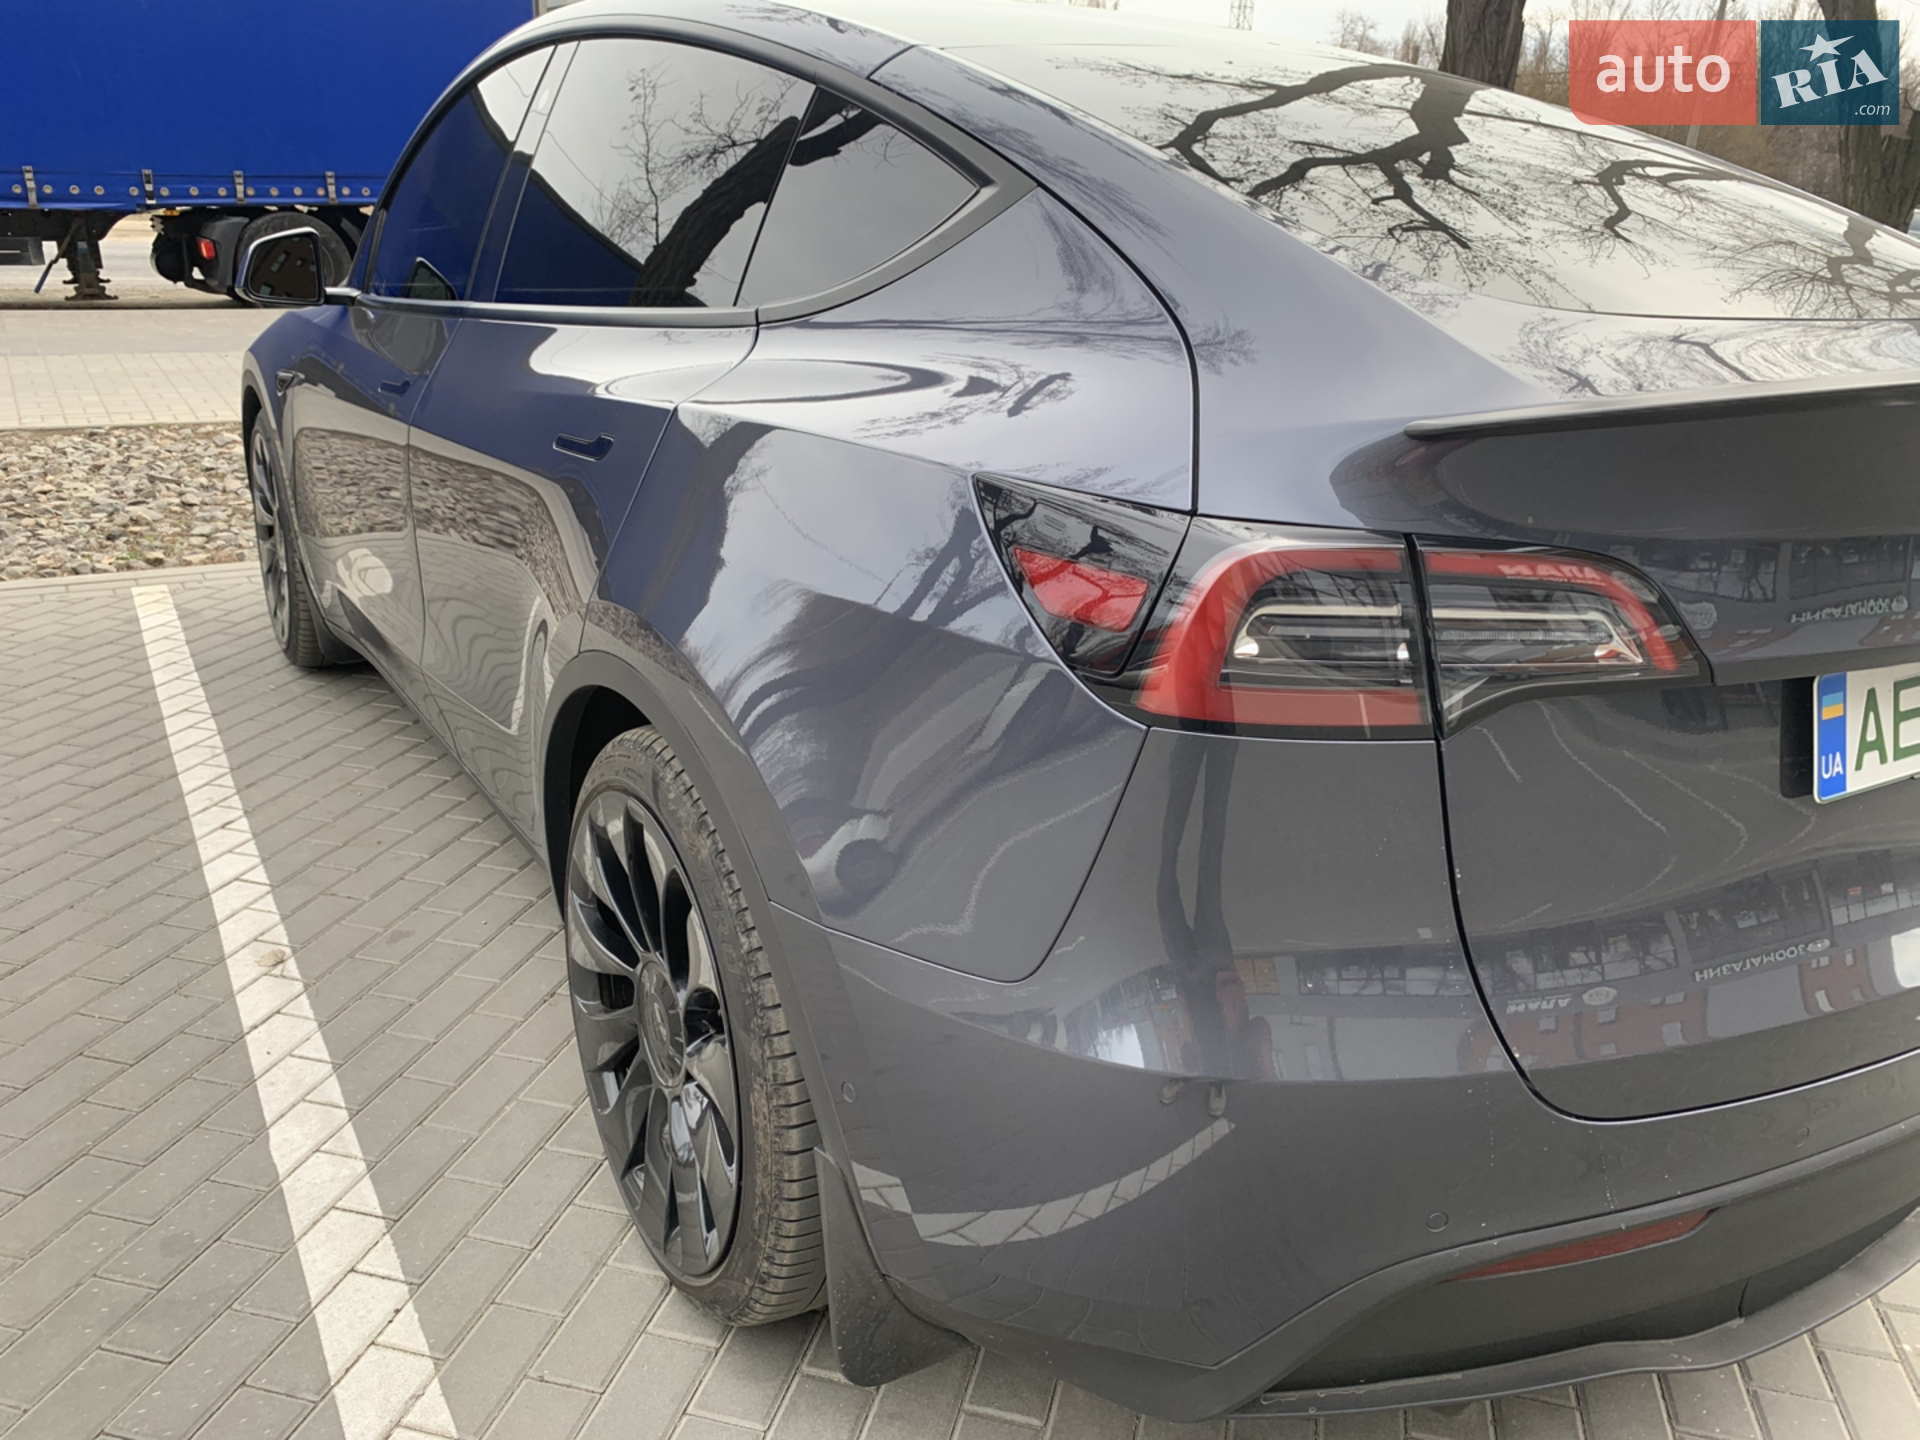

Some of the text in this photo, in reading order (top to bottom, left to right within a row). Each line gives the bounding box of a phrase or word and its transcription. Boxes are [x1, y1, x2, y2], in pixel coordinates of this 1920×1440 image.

[1855, 676, 1920, 772] AE
[1821, 751, 1844, 779] UA
[1694, 943, 1806, 983] ЗООМАГАЗИН
